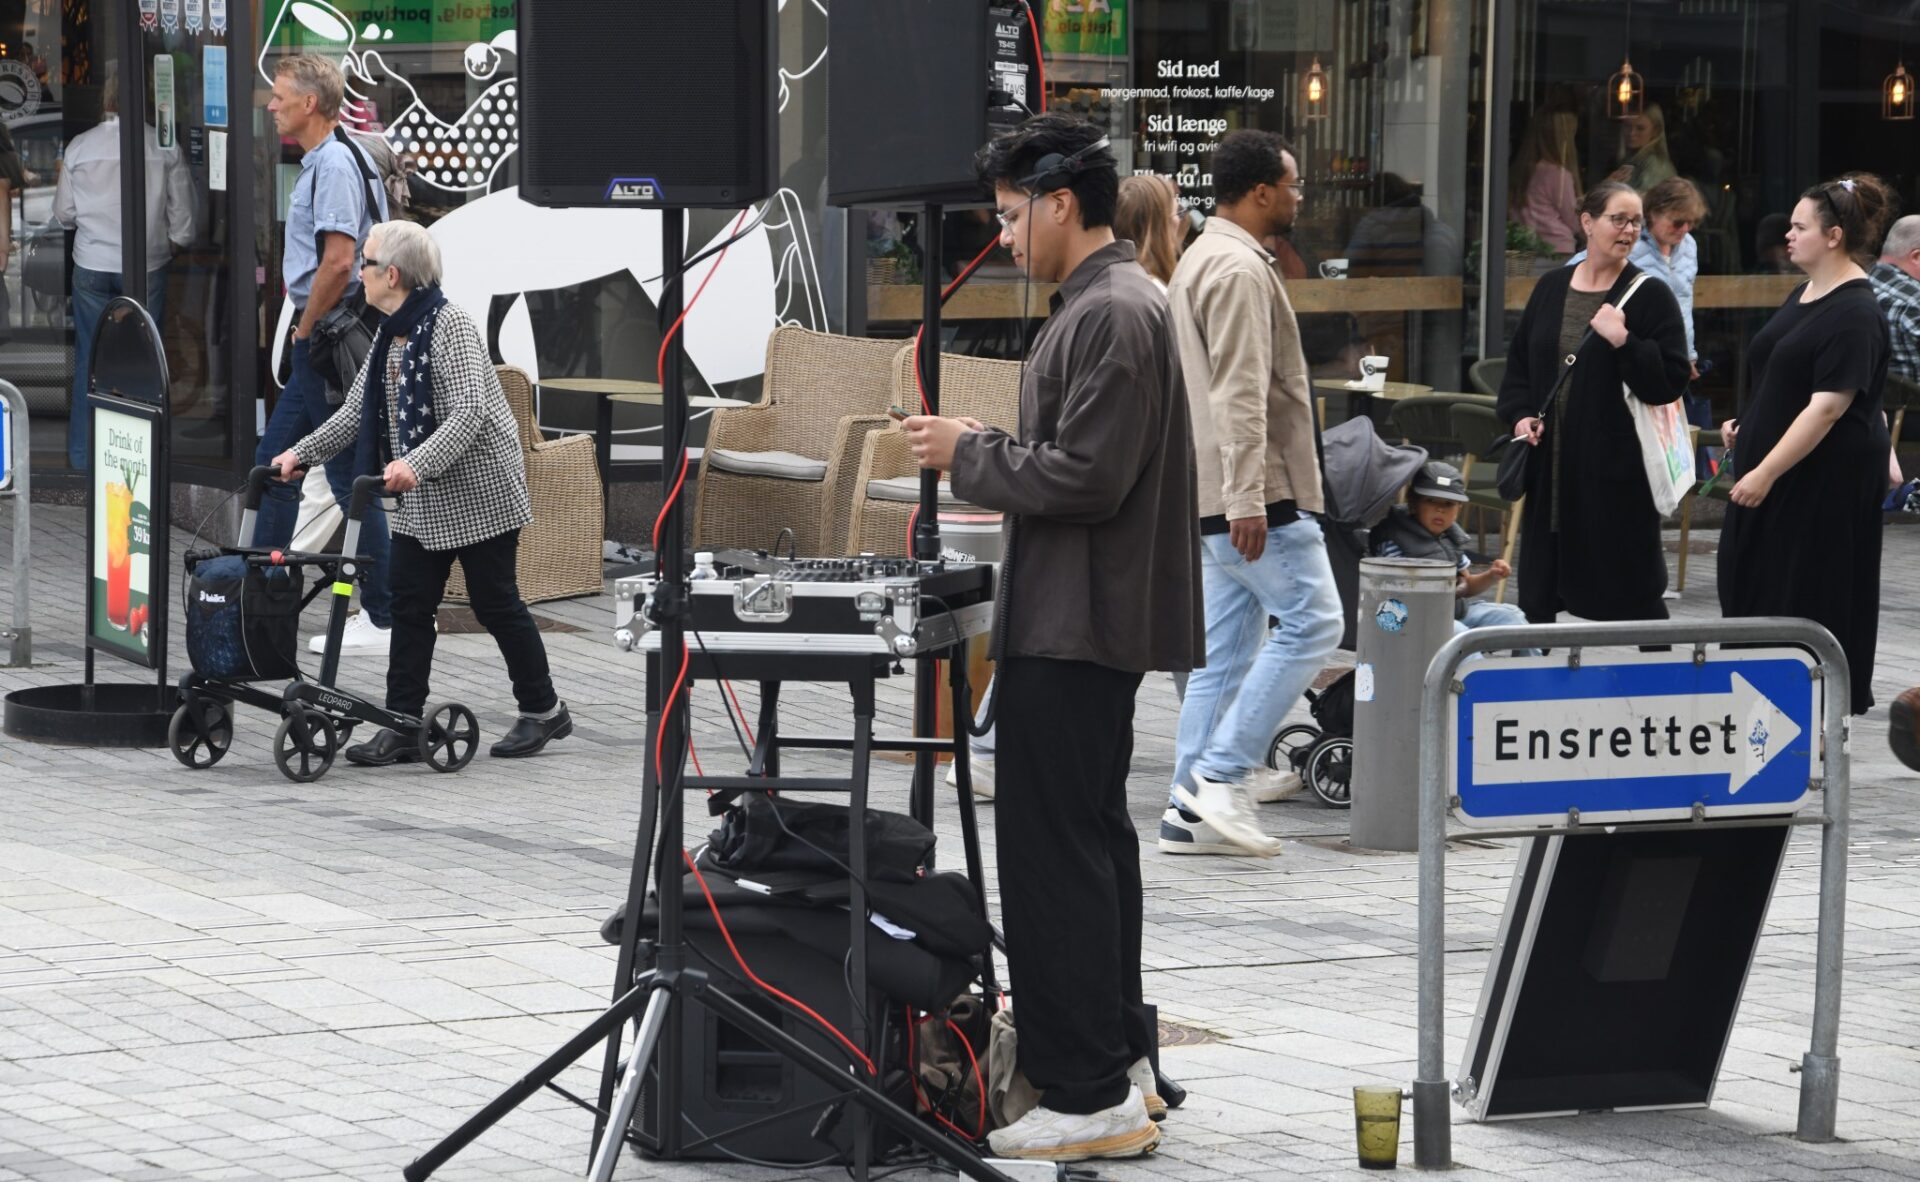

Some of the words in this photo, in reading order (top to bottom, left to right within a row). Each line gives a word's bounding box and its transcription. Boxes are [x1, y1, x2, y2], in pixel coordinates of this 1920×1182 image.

[995, 23, 1019, 35] ALTO
[1157, 60, 1183, 77] Sid
[1187, 60, 1219, 77] ned
[1101, 86, 1170, 101] morgenmad,
[1173, 86, 1213, 99] frokost,
[1214, 86, 1274, 101] kaffe/kage
[1148, 114, 1173, 132] Sid
[1177, 114, 1227, 136] længe
[1144, 140, 1156, 152] fri
[1158, 140, 1177, 152] wifi
[1180, 143, 1195, 155] og
[611, 184, 654, 196] ALTO
[109, 428, 132, 451] Drink
[134, 436, 143, 453] of
[104, 449, 118, 468] the
[120, 458, 148, 477] month
[133, 525, 142, 542] 39
[318, 692, 353, 710] LEOPARD
[1496, 714, 1736, 760] Ensrettet
